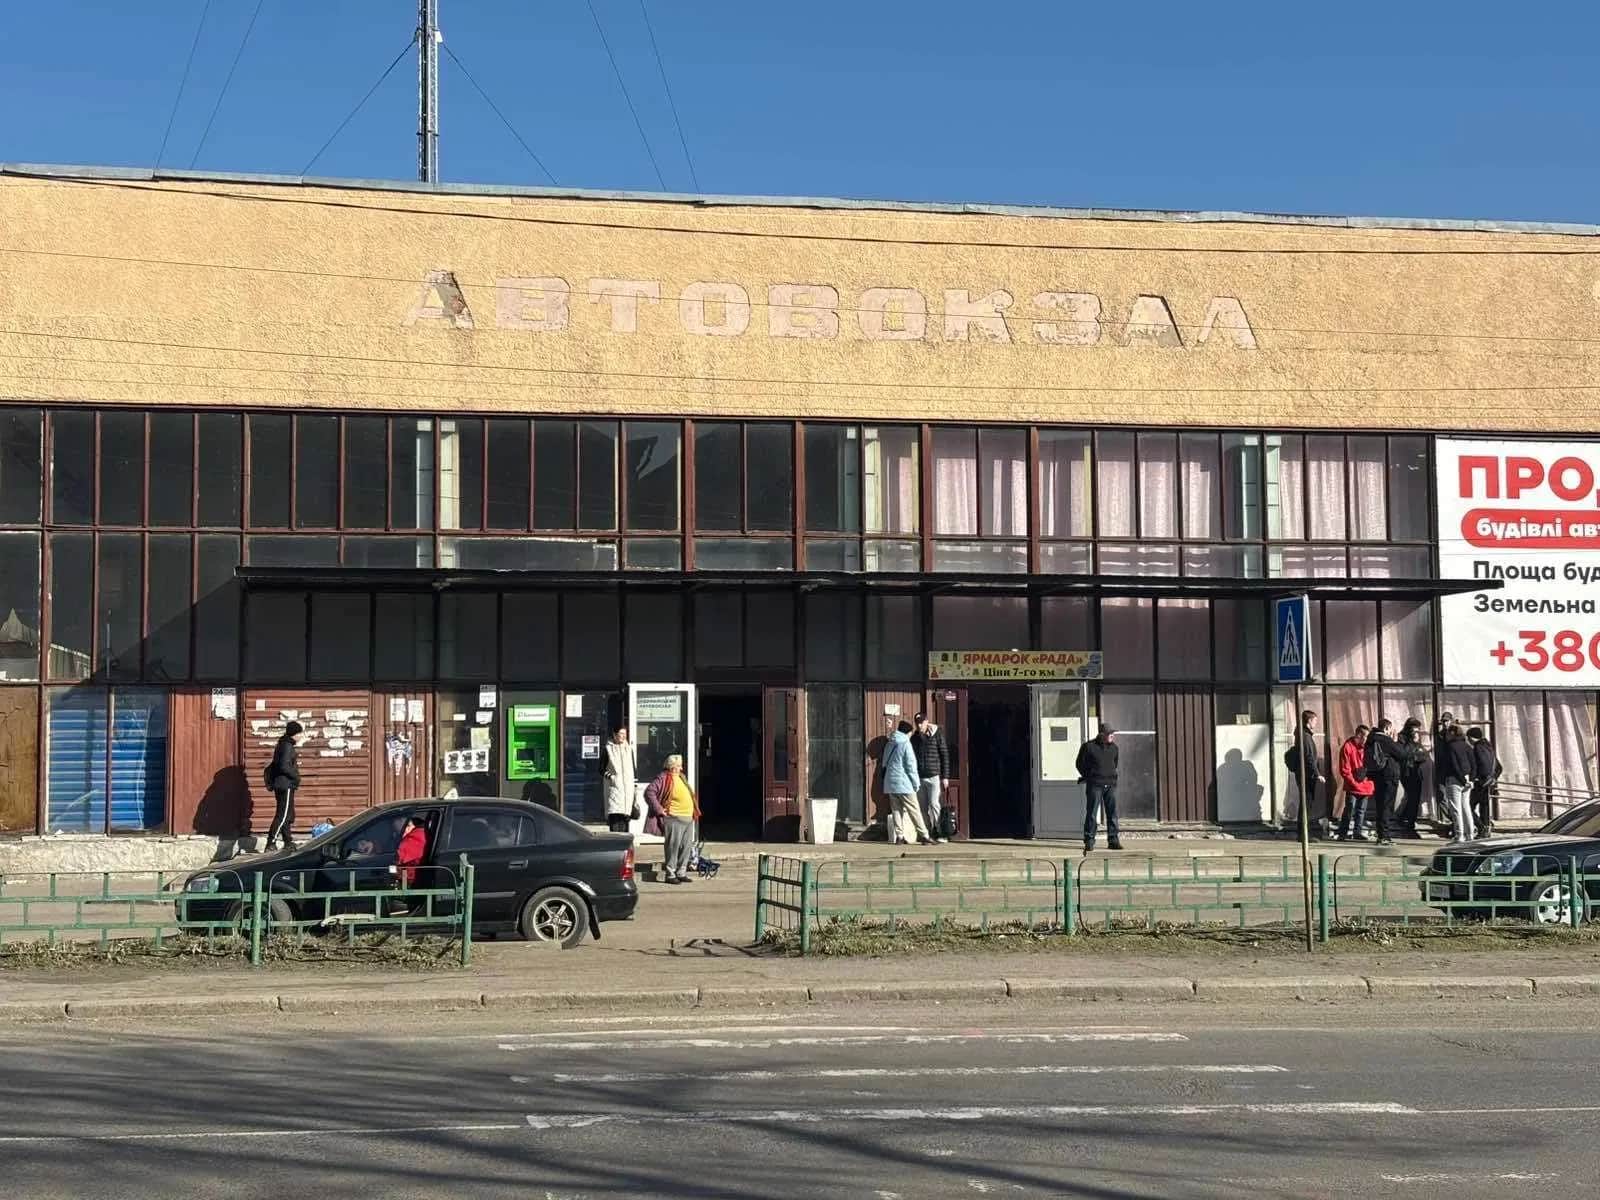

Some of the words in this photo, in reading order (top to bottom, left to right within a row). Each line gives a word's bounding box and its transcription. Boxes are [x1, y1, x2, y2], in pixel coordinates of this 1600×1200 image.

[400, 269, 1259, 350] АВТОВОКЗАЛ
[1458, 455, 1600, 507] ПРО
[1476, 517, 1562, 540] будівлі
[1569, 524, 1600, 537] ав
[1473, 560, 1555, 582] Площа
[1473, 593, 1596, 613] Земельна
[963, 653, 1030, 665] ЯРМАРОК
[1032, 653, 1083, 665] «РАДА»
[984, 668, 1011, 677] Ціни
[1012, 668, 1036, 677] 7-го
[1040, 669, 1055, 677] км
